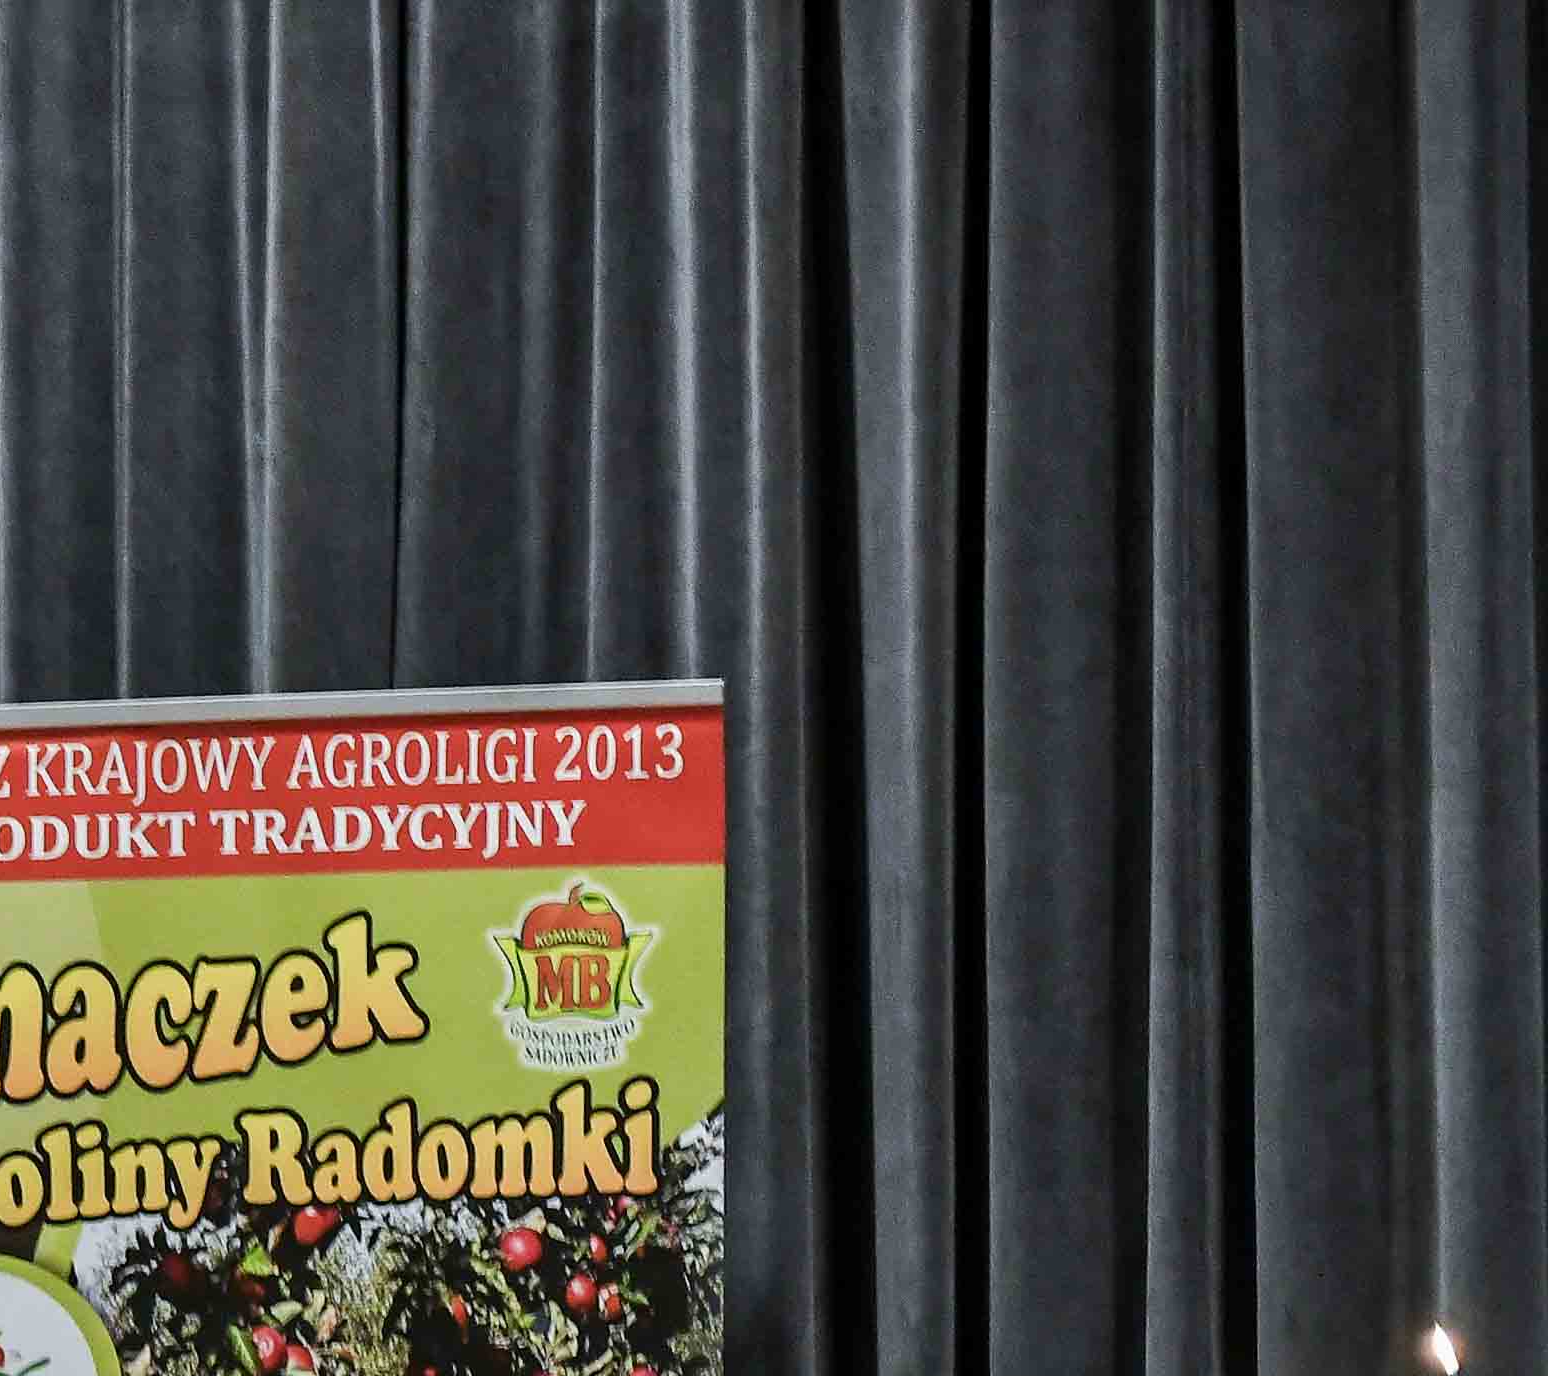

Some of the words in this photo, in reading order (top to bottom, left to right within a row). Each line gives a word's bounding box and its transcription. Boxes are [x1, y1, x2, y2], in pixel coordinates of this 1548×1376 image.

[25, 736, 275, 808] KRAJOWY
[286, 726, 540, 790] AGROLIGI
[553, 722, 686, 782] 2013
[209, 799, 588, 861] TRADYCYJNY
[534, 954, 613, 1011] MB
[237, 1076, 662, 1213] Radomki
